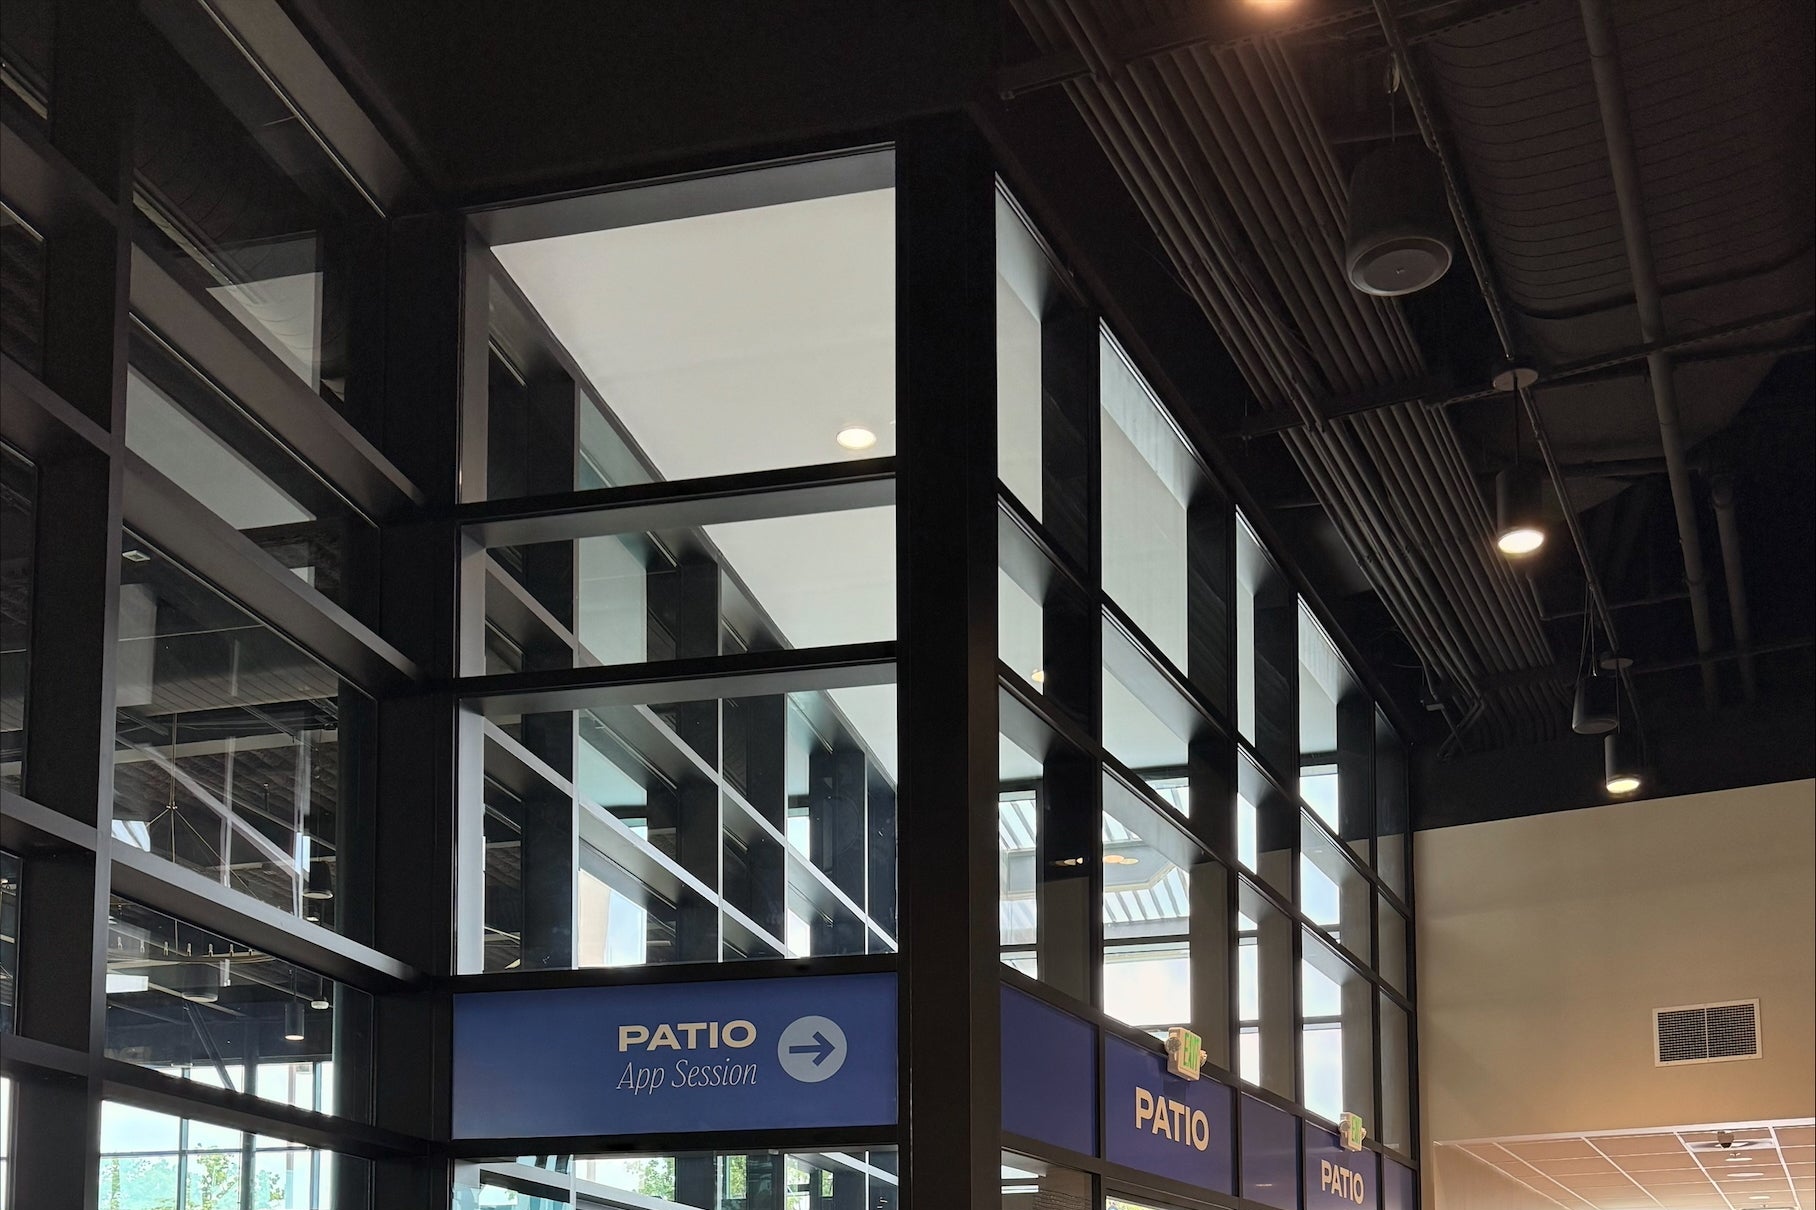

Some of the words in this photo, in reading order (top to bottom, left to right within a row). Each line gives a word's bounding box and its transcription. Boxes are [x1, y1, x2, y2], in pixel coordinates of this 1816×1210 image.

[618, 1019, 758, 1052] PATIO
[1183, 1032, 1199, 1071] EXIT
[616, 1061, 665, 1095] App
[671, 1057, 758, 1087] Session
[1135, 1086, 1210, 1152] PATIO
[1320, 1159, 1365, 1205] PATIO
